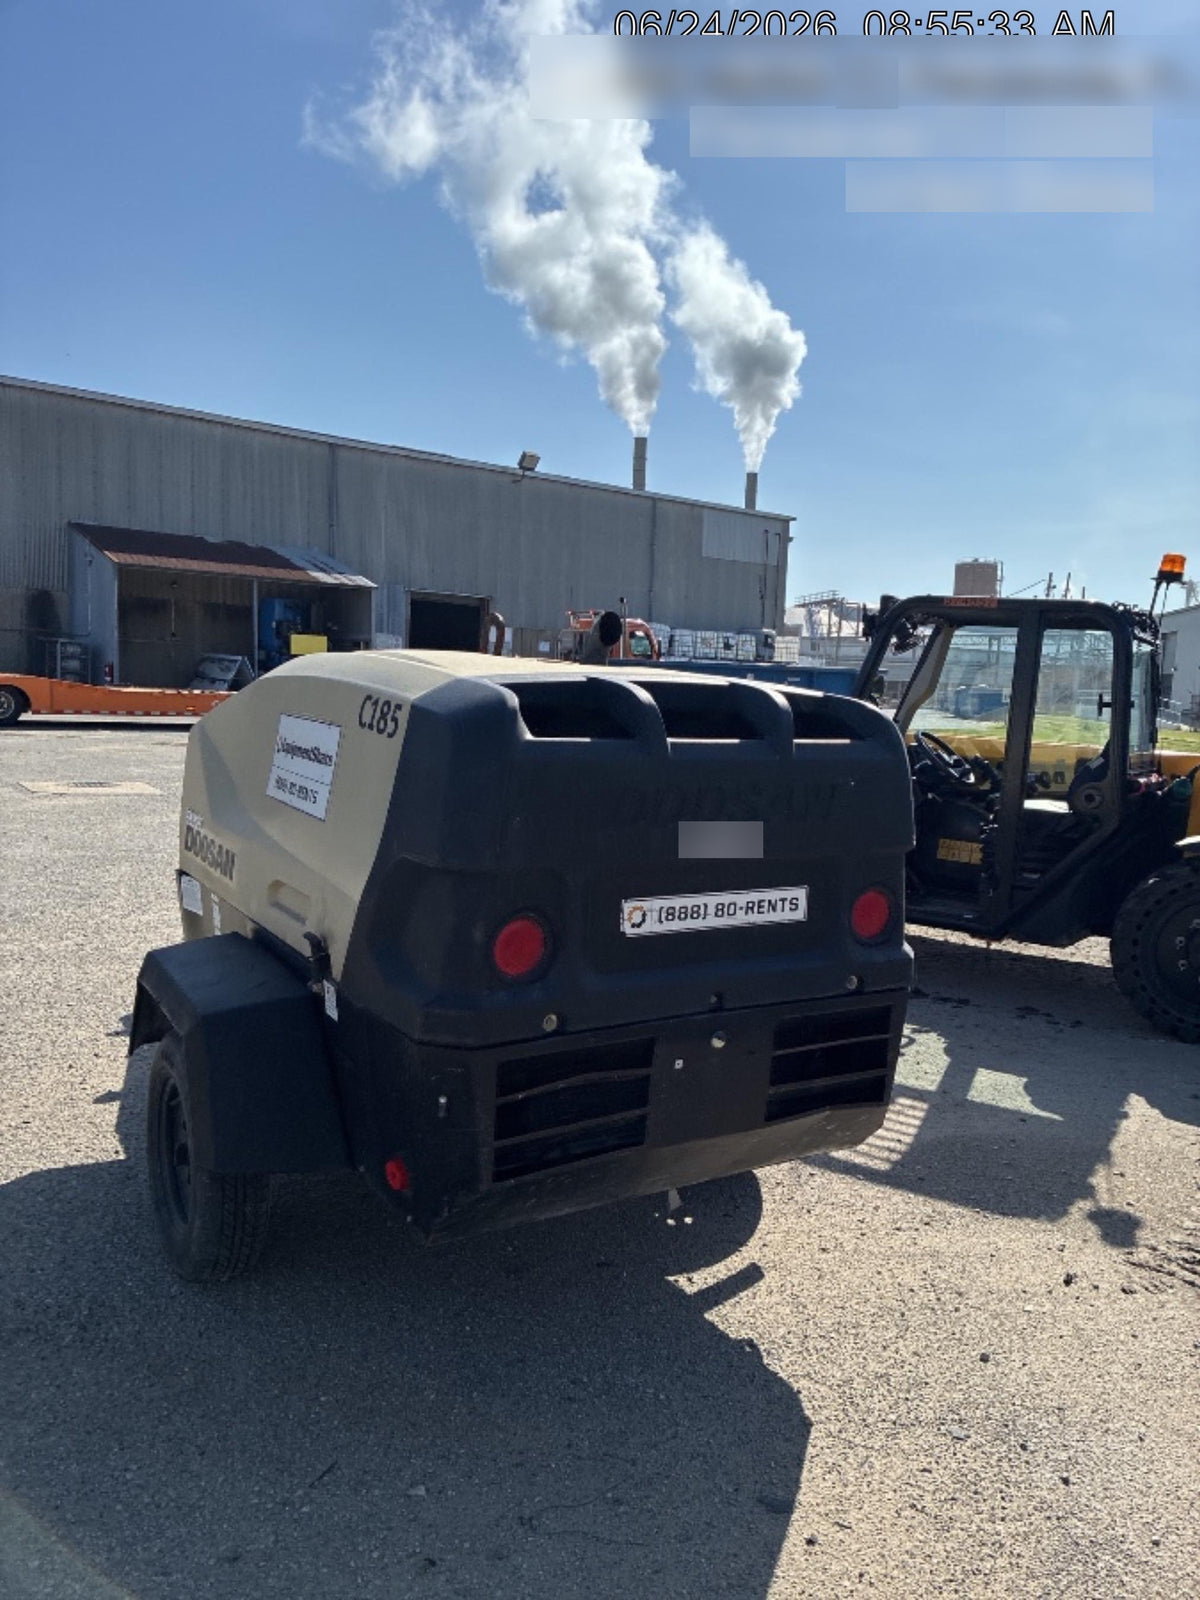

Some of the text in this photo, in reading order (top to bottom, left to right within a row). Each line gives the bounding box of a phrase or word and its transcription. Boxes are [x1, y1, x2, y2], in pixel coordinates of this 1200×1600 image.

[358, 694, 402, 739] C185
[184, 825, 236, 882] DOOSAN
[658, 897, 800, 924] (888) 80-RENTS
